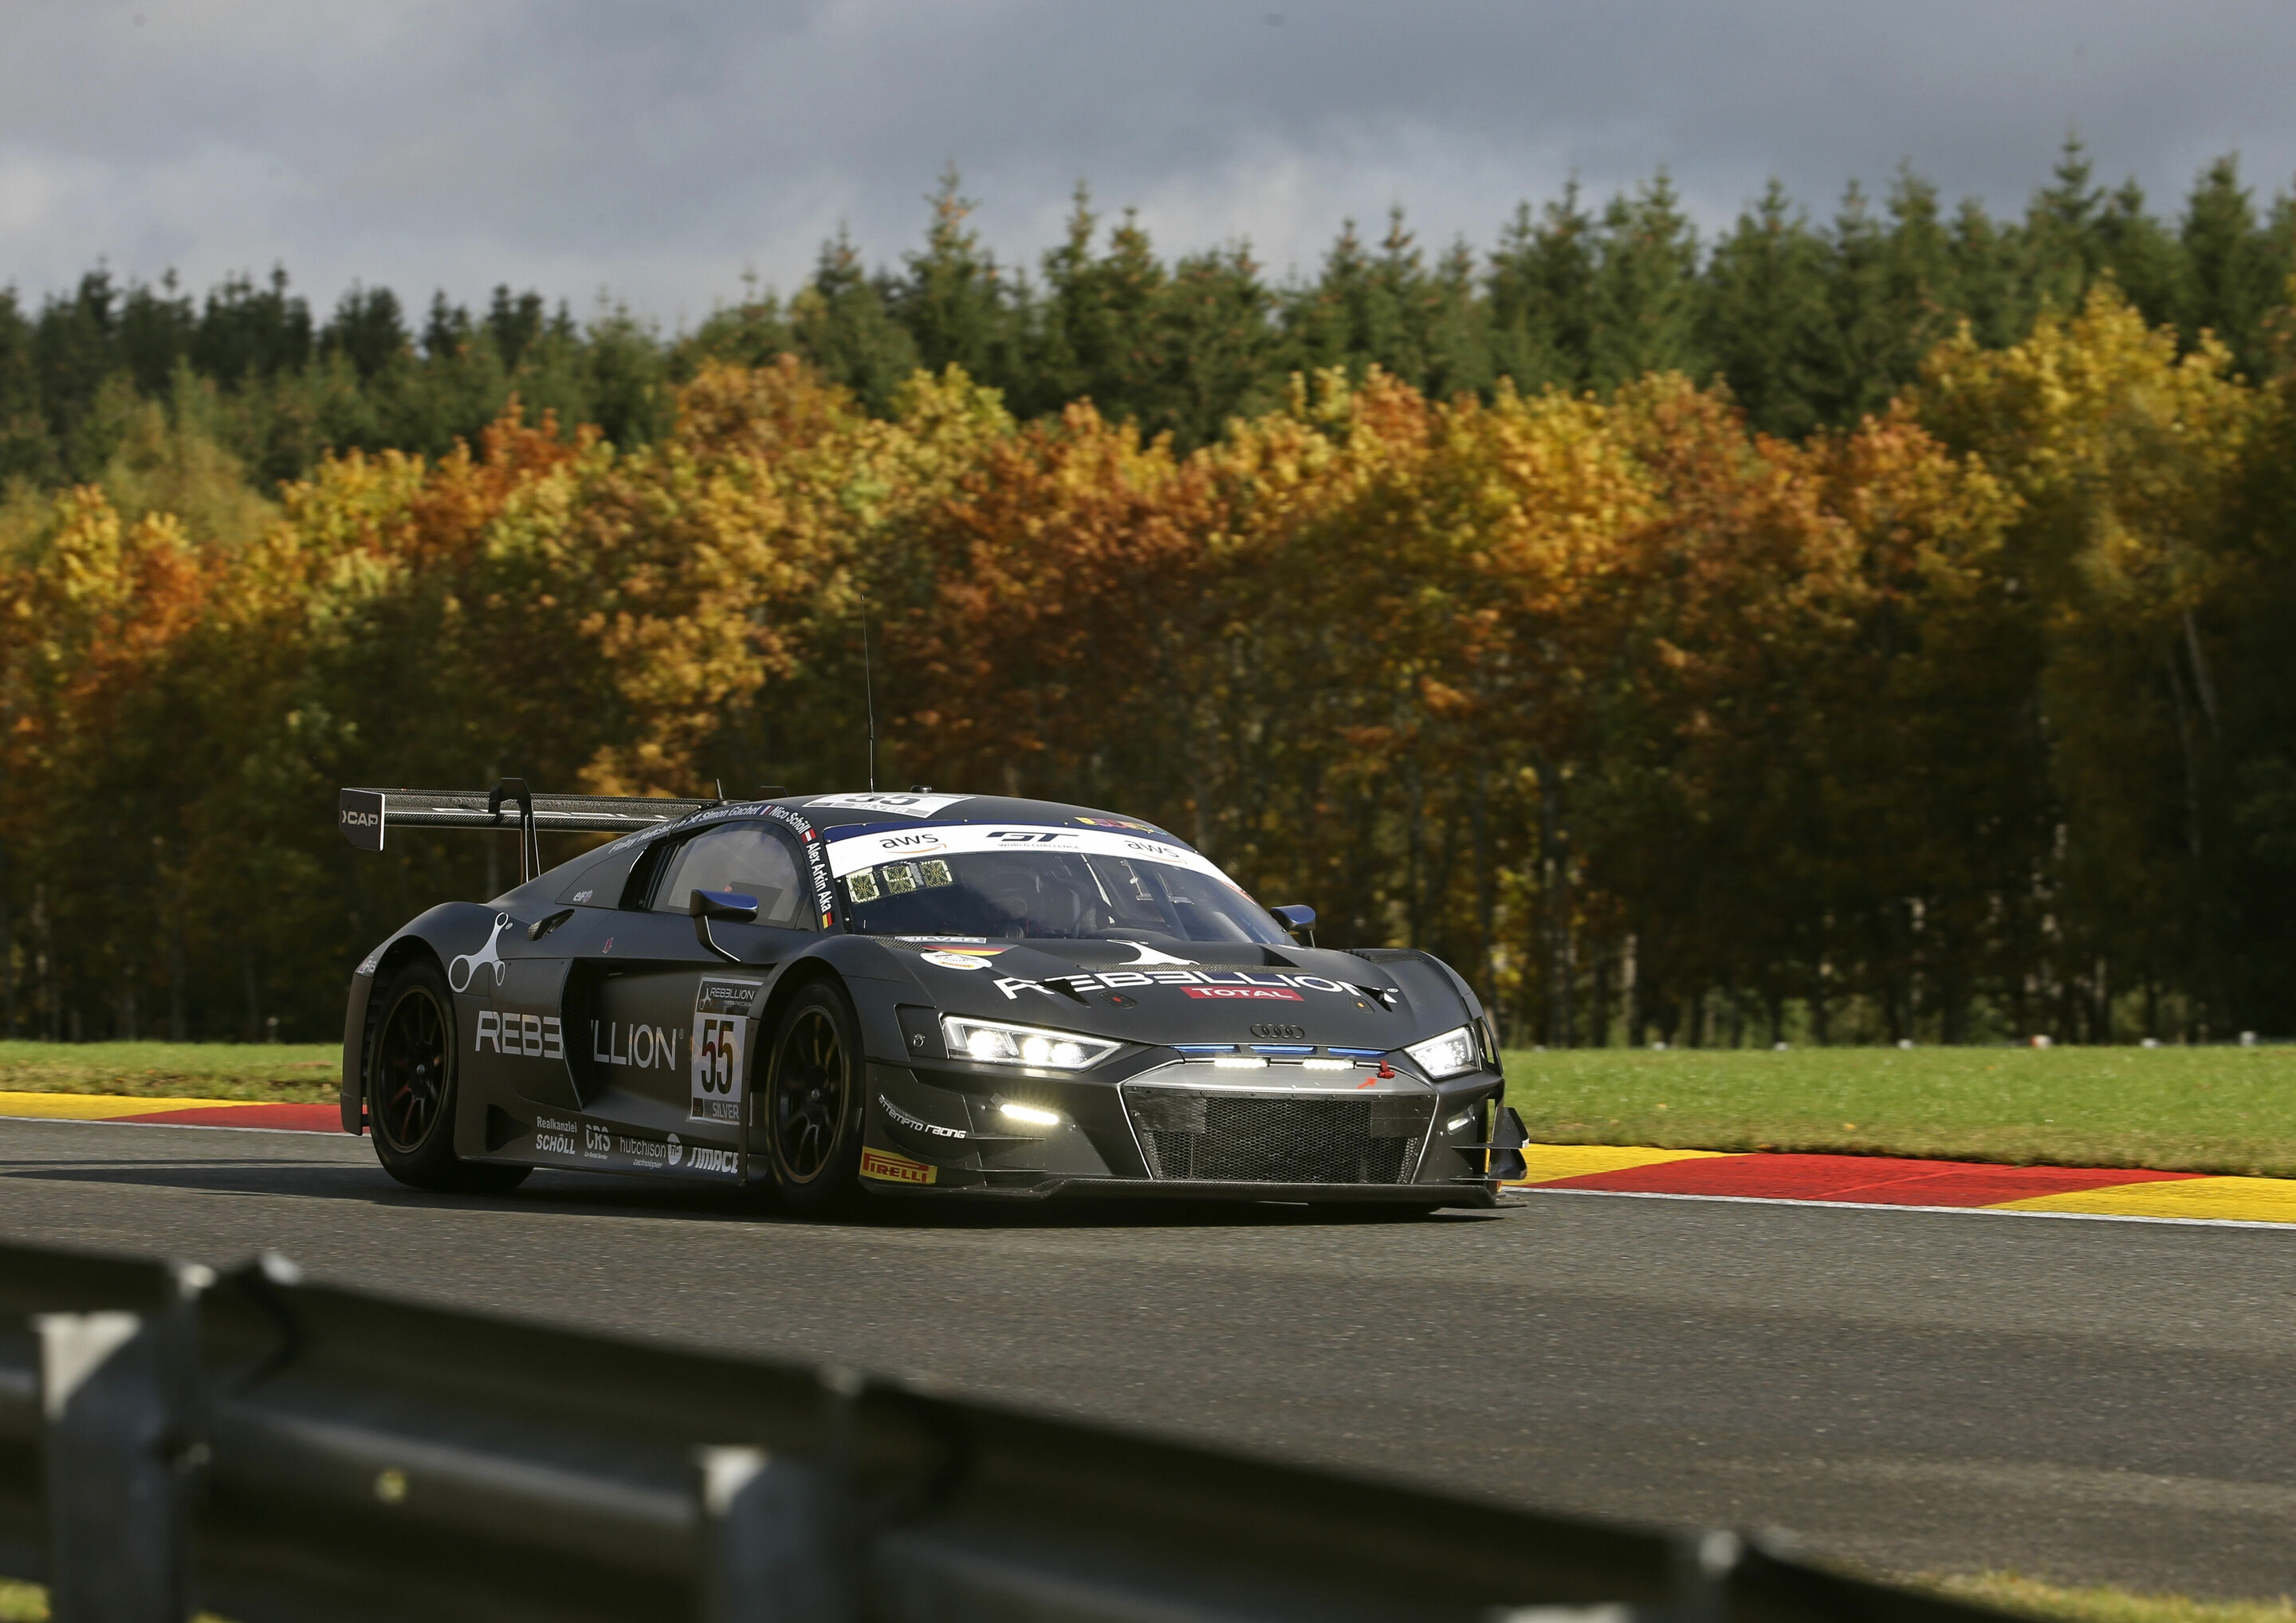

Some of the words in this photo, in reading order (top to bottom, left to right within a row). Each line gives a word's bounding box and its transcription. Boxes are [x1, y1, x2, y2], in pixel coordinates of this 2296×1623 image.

[698, 808, 728, 822] Simon
[728, 805, 762, 816] Gachet
[769, 806, 788, 819] Nico
[786, 813, 812, 835] Schöll
[879, 834, 939, 848] aws
[1125, 840, 1180, 858] aws
[806, 842, 822, 866] Alex
[811, 863, 831, 892] Arkin
[817, 891, 833, 914] Aka
[710, 988, 755, 1000] REBELLION
[993, 971, 1397, 1003] REBELLION
[1191, 988, 1294, 998] TOTAL
[702, 1019, 734, 1095] 55
[712, 1103, 740, 1120] SILVER
[537, 1116, 577, 1133] Realkanzlei
[536, 1134, 576, 1155] SCHÖLL
[585, 1124, 611, 1152] CRS
[619, 1137, 666, 1158] hutchison
[633, 1159, 662, 1169] technologies
[863, 1153, 930, 1183] PIRELLI
